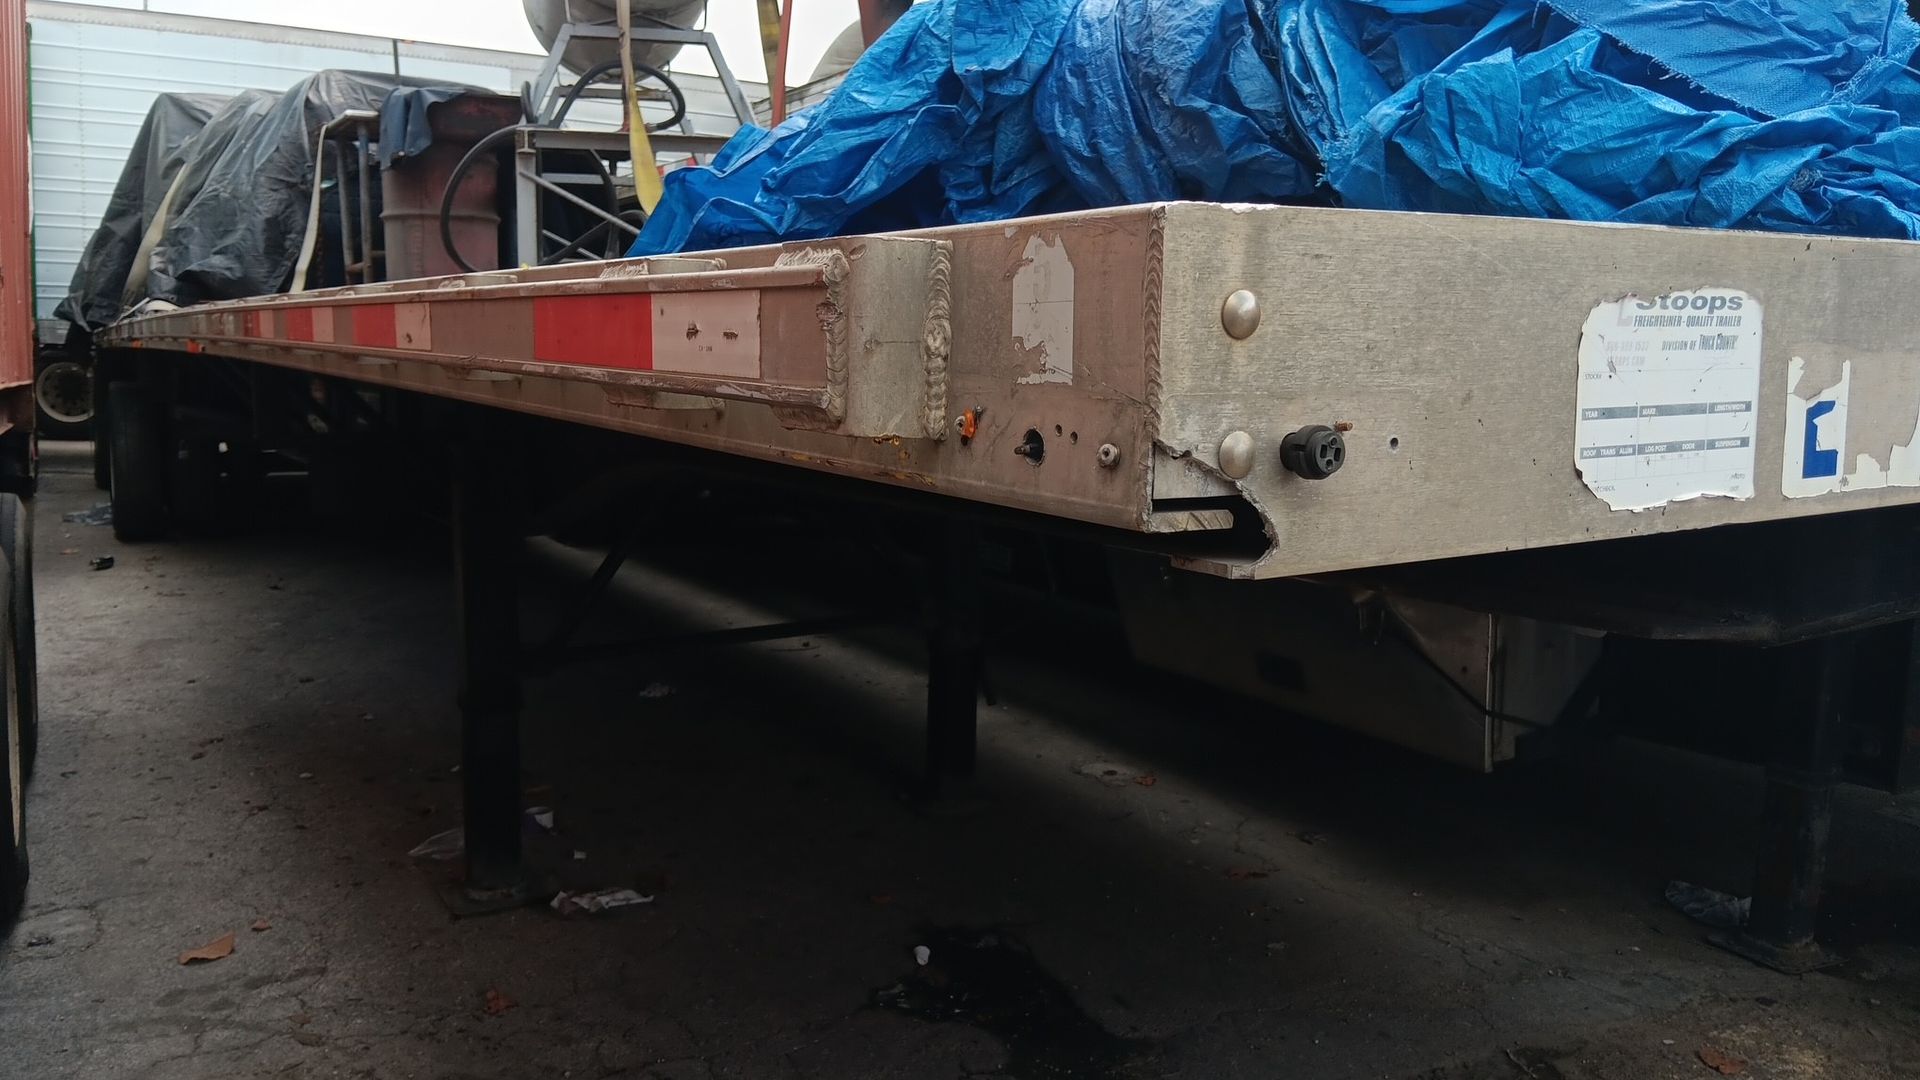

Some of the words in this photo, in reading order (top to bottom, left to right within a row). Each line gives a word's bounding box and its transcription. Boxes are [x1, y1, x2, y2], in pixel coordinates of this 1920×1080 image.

[1715, 315, 1742, 327] TRAILER
[1661, 340, 1688, 351] DIVISION
[1689, 340, 1697, 350] OF
[1585, 410, 1599, 418] YEAR
[1642, 407, 1656, 415] MAKE
[1655, 444, 1667, 452] POST
[1682, 442, 1695, 450] DOOR
[1583, 449, 1597, 457] ROOF
[1600, 448, 1616, 456] TRANS
